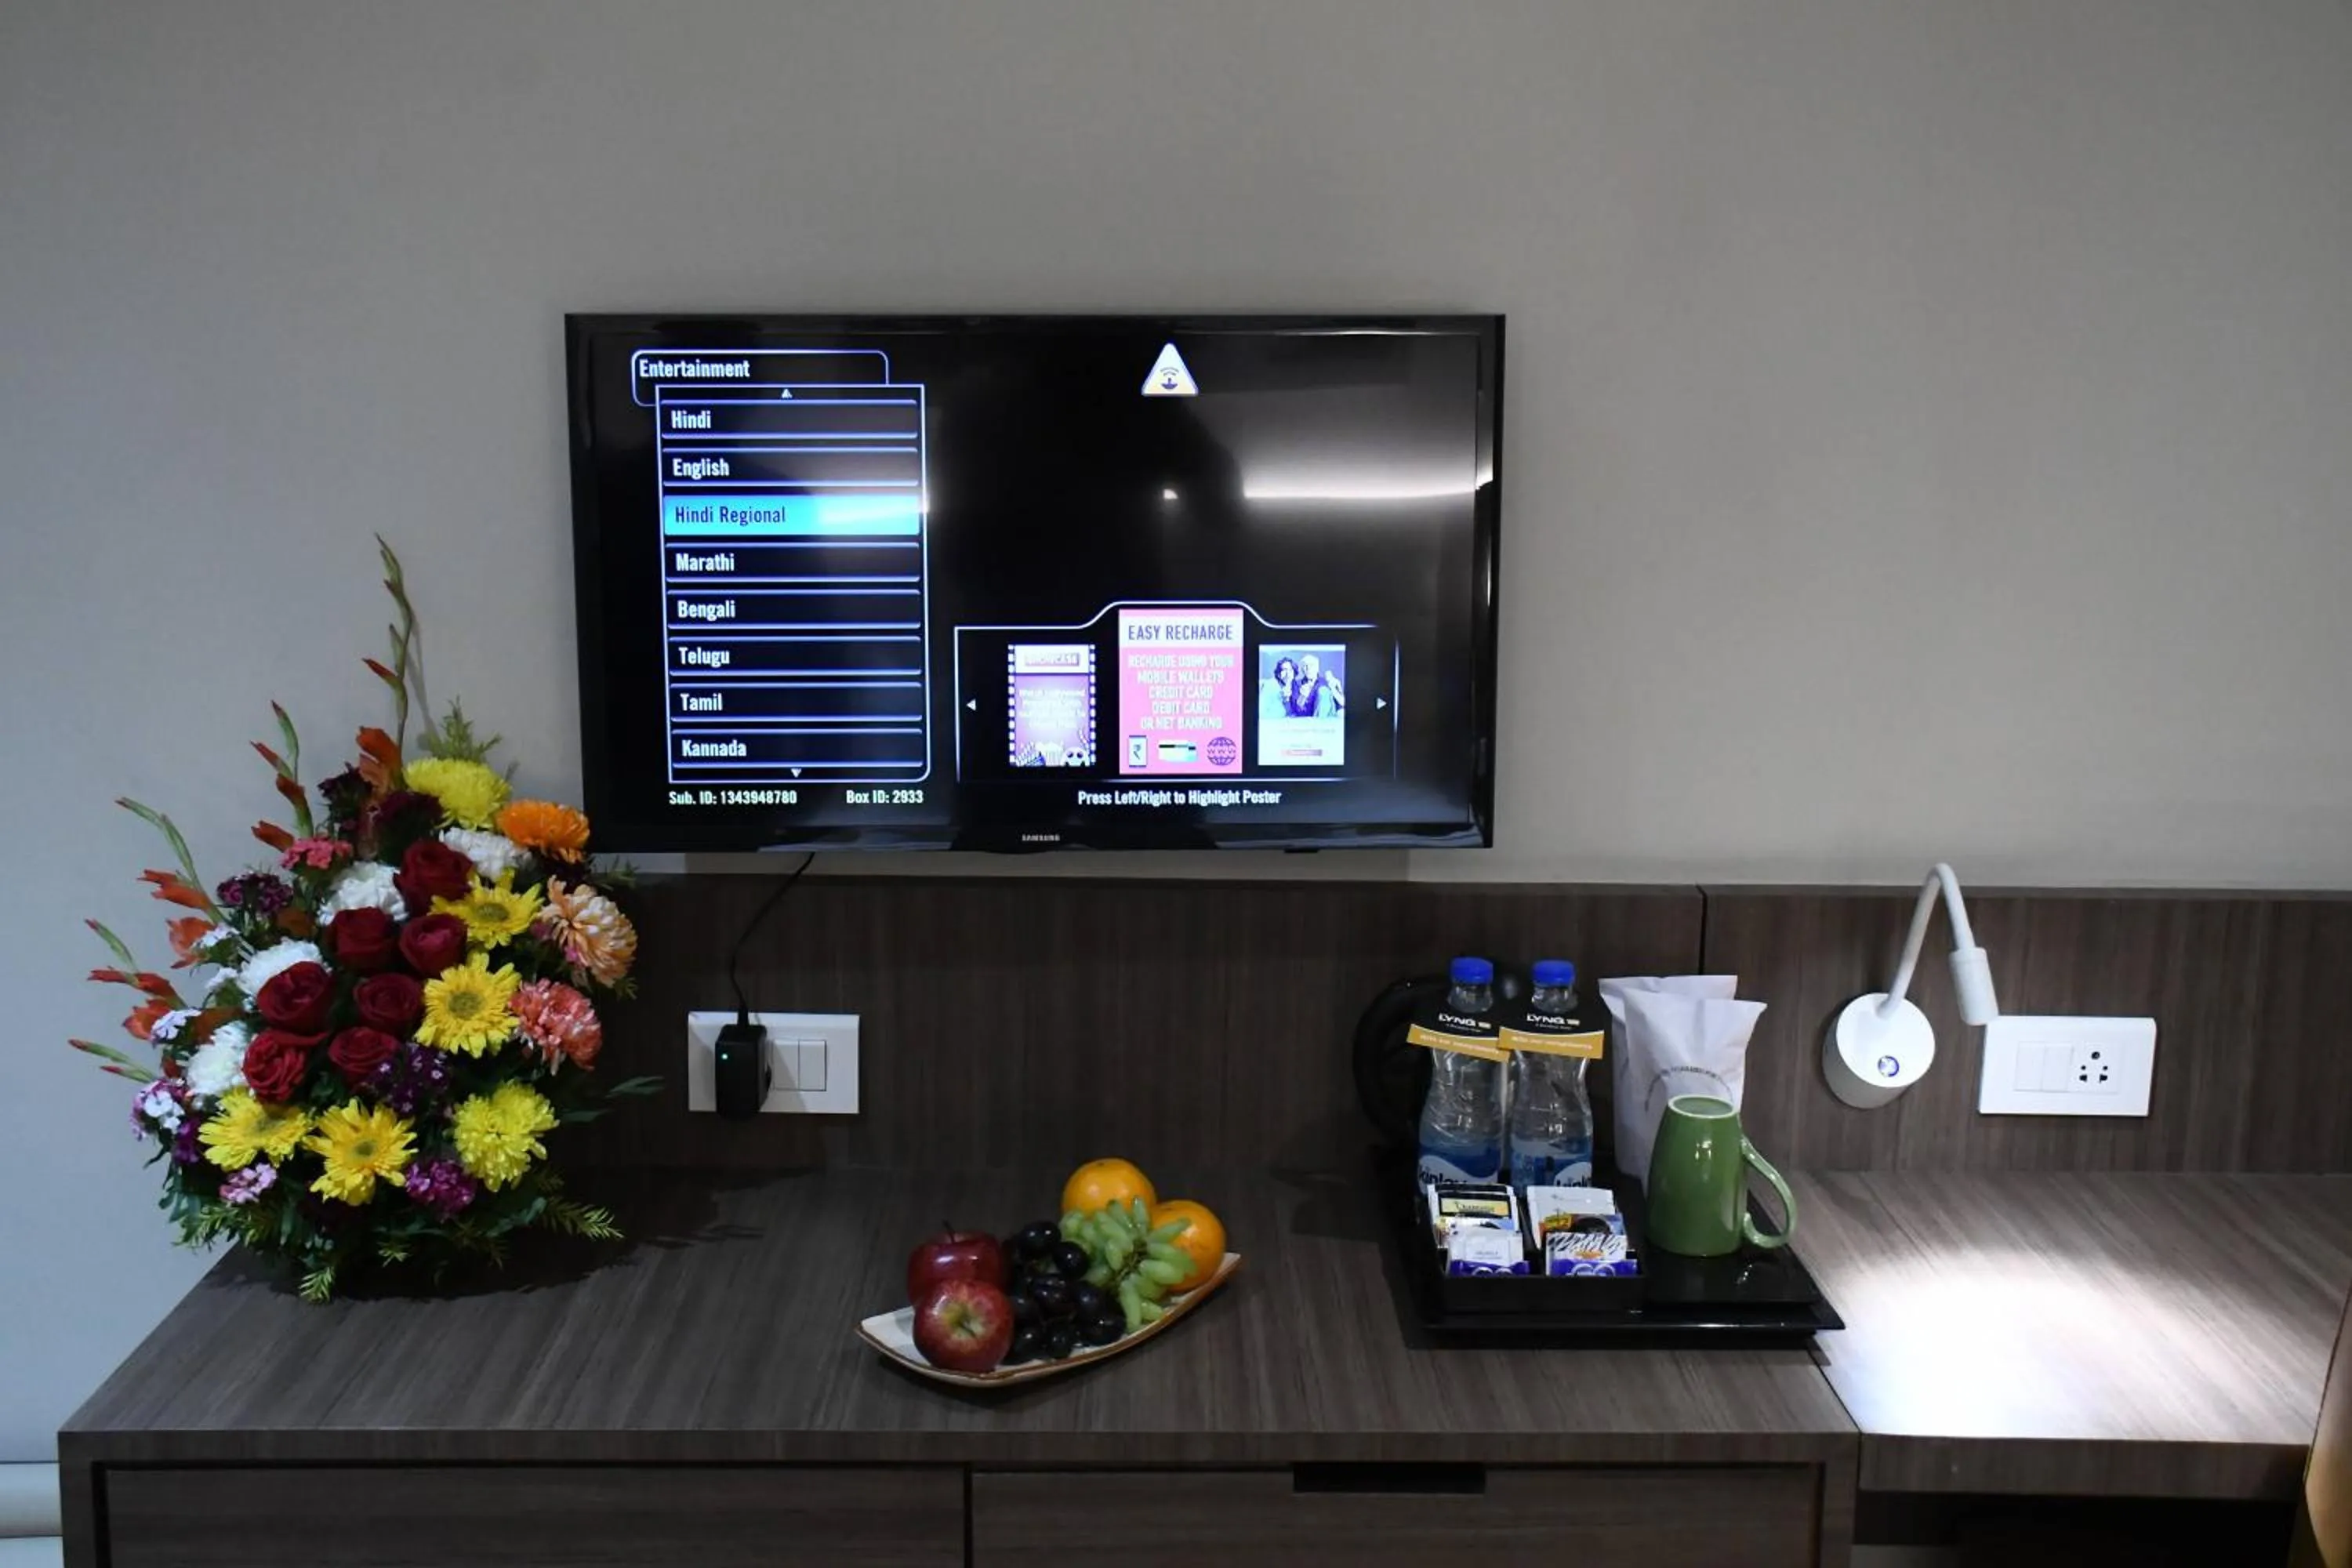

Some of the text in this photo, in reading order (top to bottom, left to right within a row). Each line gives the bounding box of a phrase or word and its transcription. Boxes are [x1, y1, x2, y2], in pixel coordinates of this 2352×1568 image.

[639, 359, 750, 379] Entertainment
[671, 410, 712, 430] Hindi
[673, 458, 730, 480] English
[674, 506, 786, 526] Hindi Regional
[676, 553, 735, 572] Marathi
[677, 600, 736, 621] Bengali
[1128, 625, 1233, 641] EASY RECHARGE
[678, 647, 731, 668] Telugu
[1178, 670, 1225, 684] WALLETS
[1149, 685, 1213, 699] CREDIT CARD
[680, 693, 723, 711] Tamil
[681, 739, 747, 757] Kannada
[669, 790, 697, 805] Sub.
[699, 790, 717, 805] ID:
[846, 789, 869, 804] Box
[873, 789, 890, 804] ID:
[1078, 789, 1282, 807] Press Left/Right to Highlight Poster
